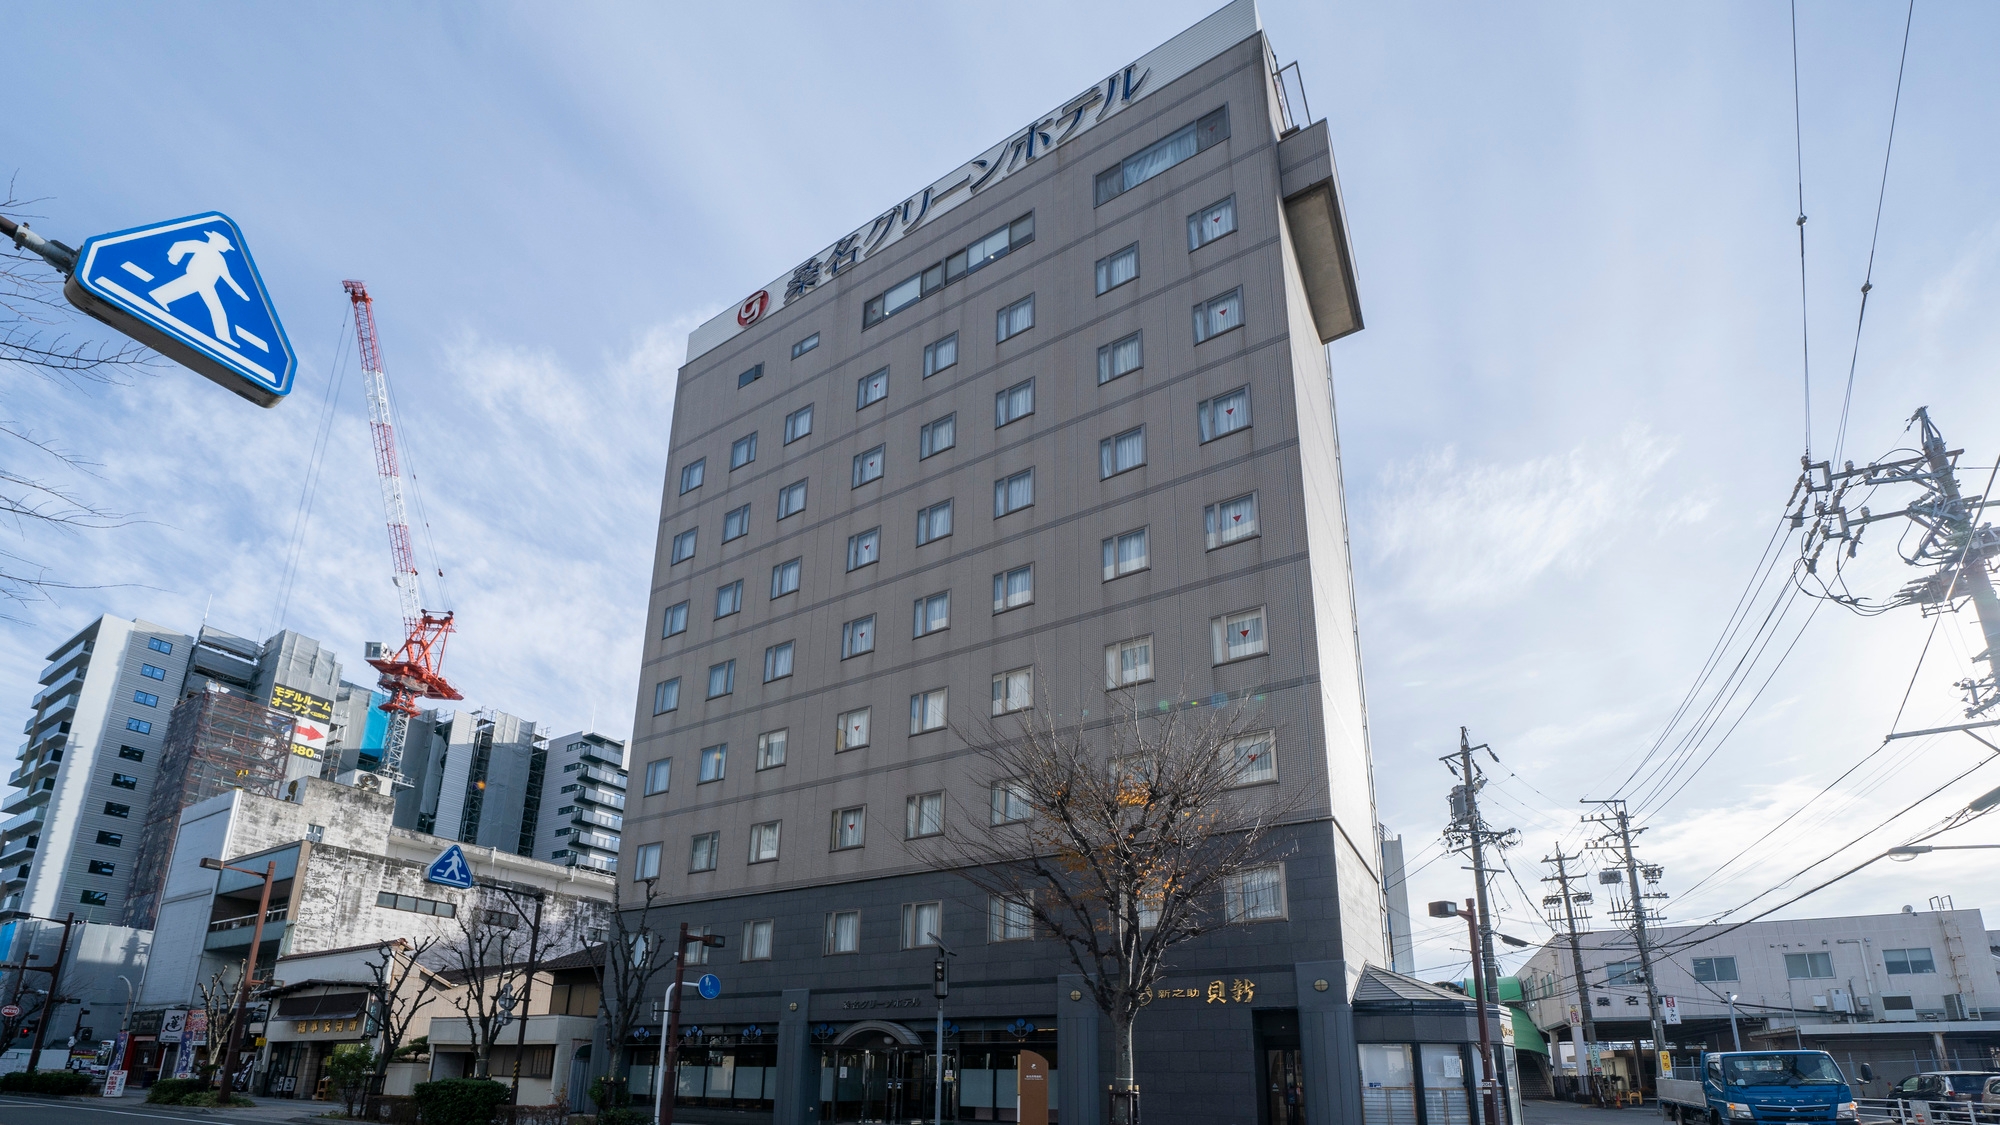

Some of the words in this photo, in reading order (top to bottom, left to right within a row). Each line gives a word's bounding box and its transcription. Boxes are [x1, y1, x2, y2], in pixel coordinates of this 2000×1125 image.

[784, 63, 1152, 305] 桑名グリーンホテル
[272, 697, 311, 715] オープン
[274, 686, 332, 712] モデルルーム
[842, 997, 921, 1010] 桑名グリーンホテル
[1157, 988, 1201, 999] 新之助
[1206, 978, 1257, 1004] 貝新
